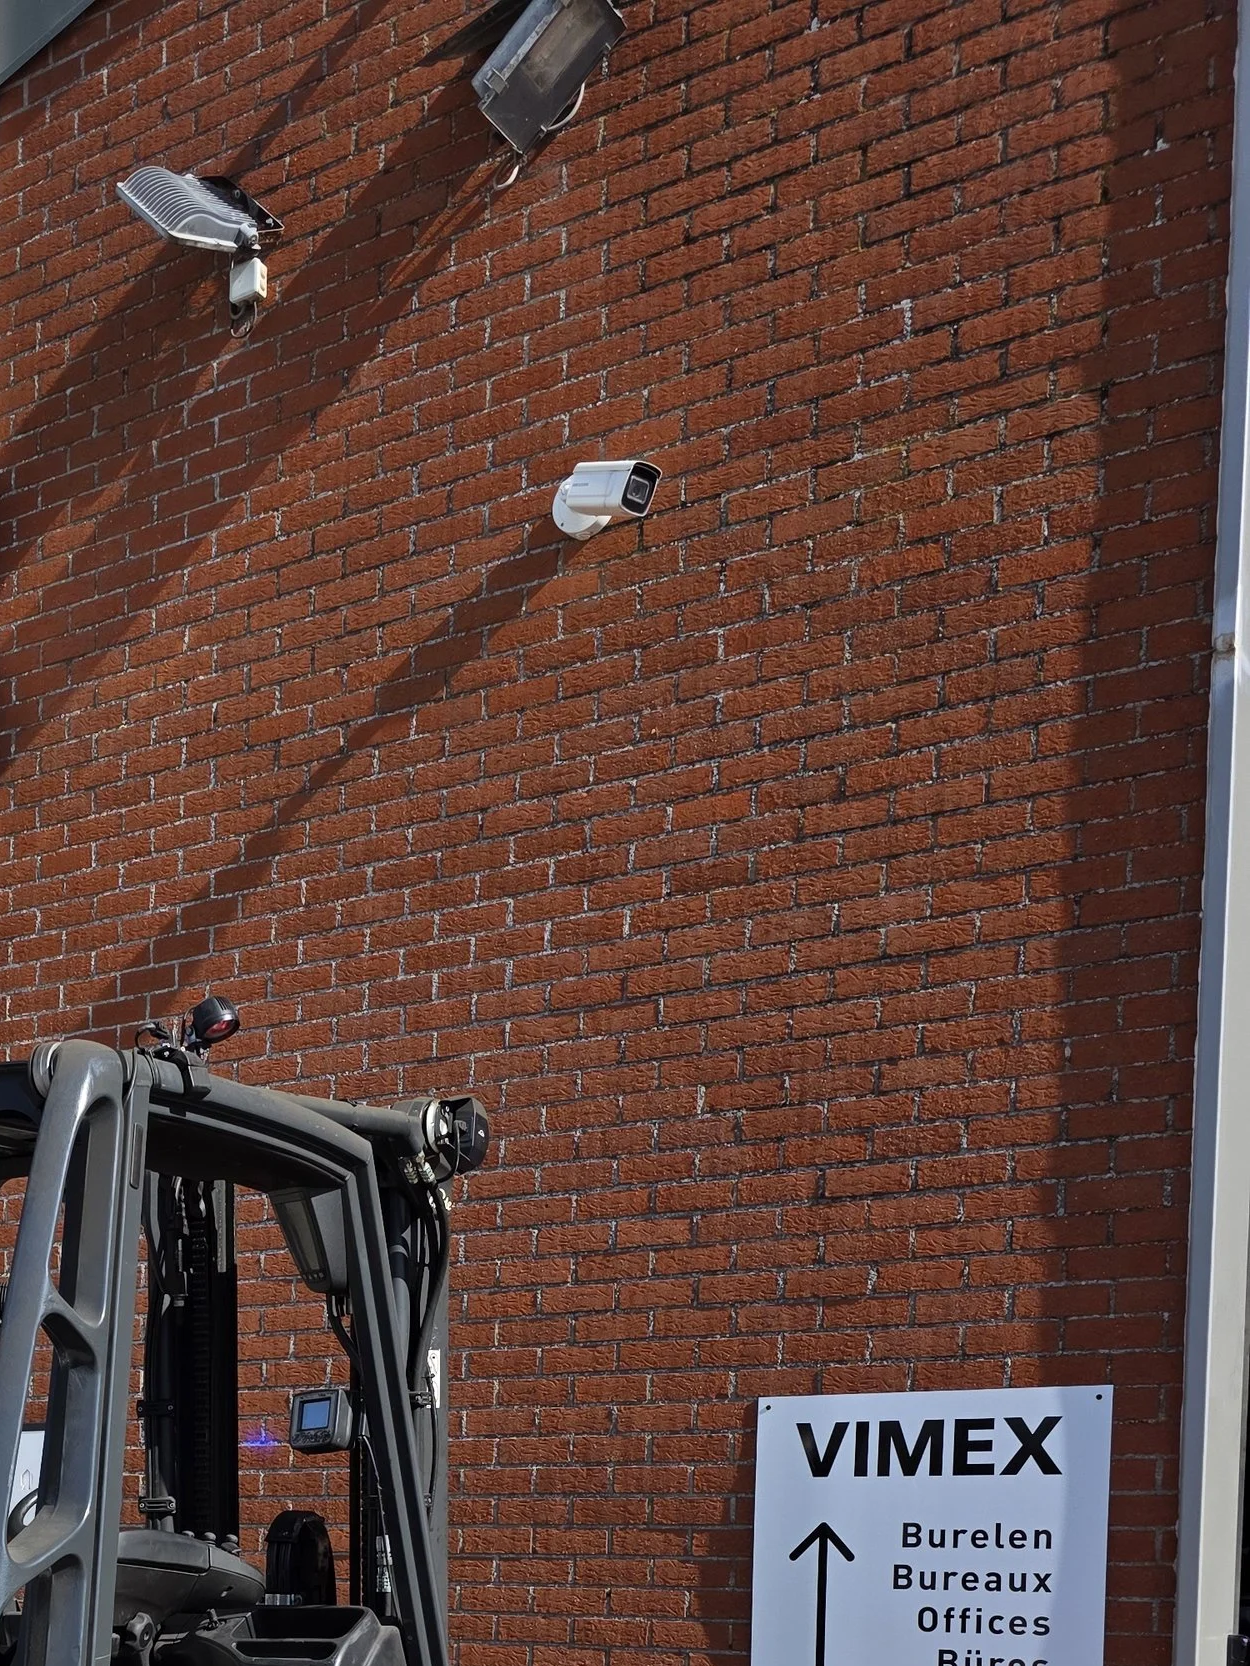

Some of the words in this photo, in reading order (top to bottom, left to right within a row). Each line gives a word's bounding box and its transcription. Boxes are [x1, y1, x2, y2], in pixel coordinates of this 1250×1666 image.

[796, 1416, 1063, 1478] VIMEX
[902, 1522, 1052, 1550] Burelen
[893, 1564, 1052, 1593] Bureaux
[917, 1606, 1051, 1636] Offices
